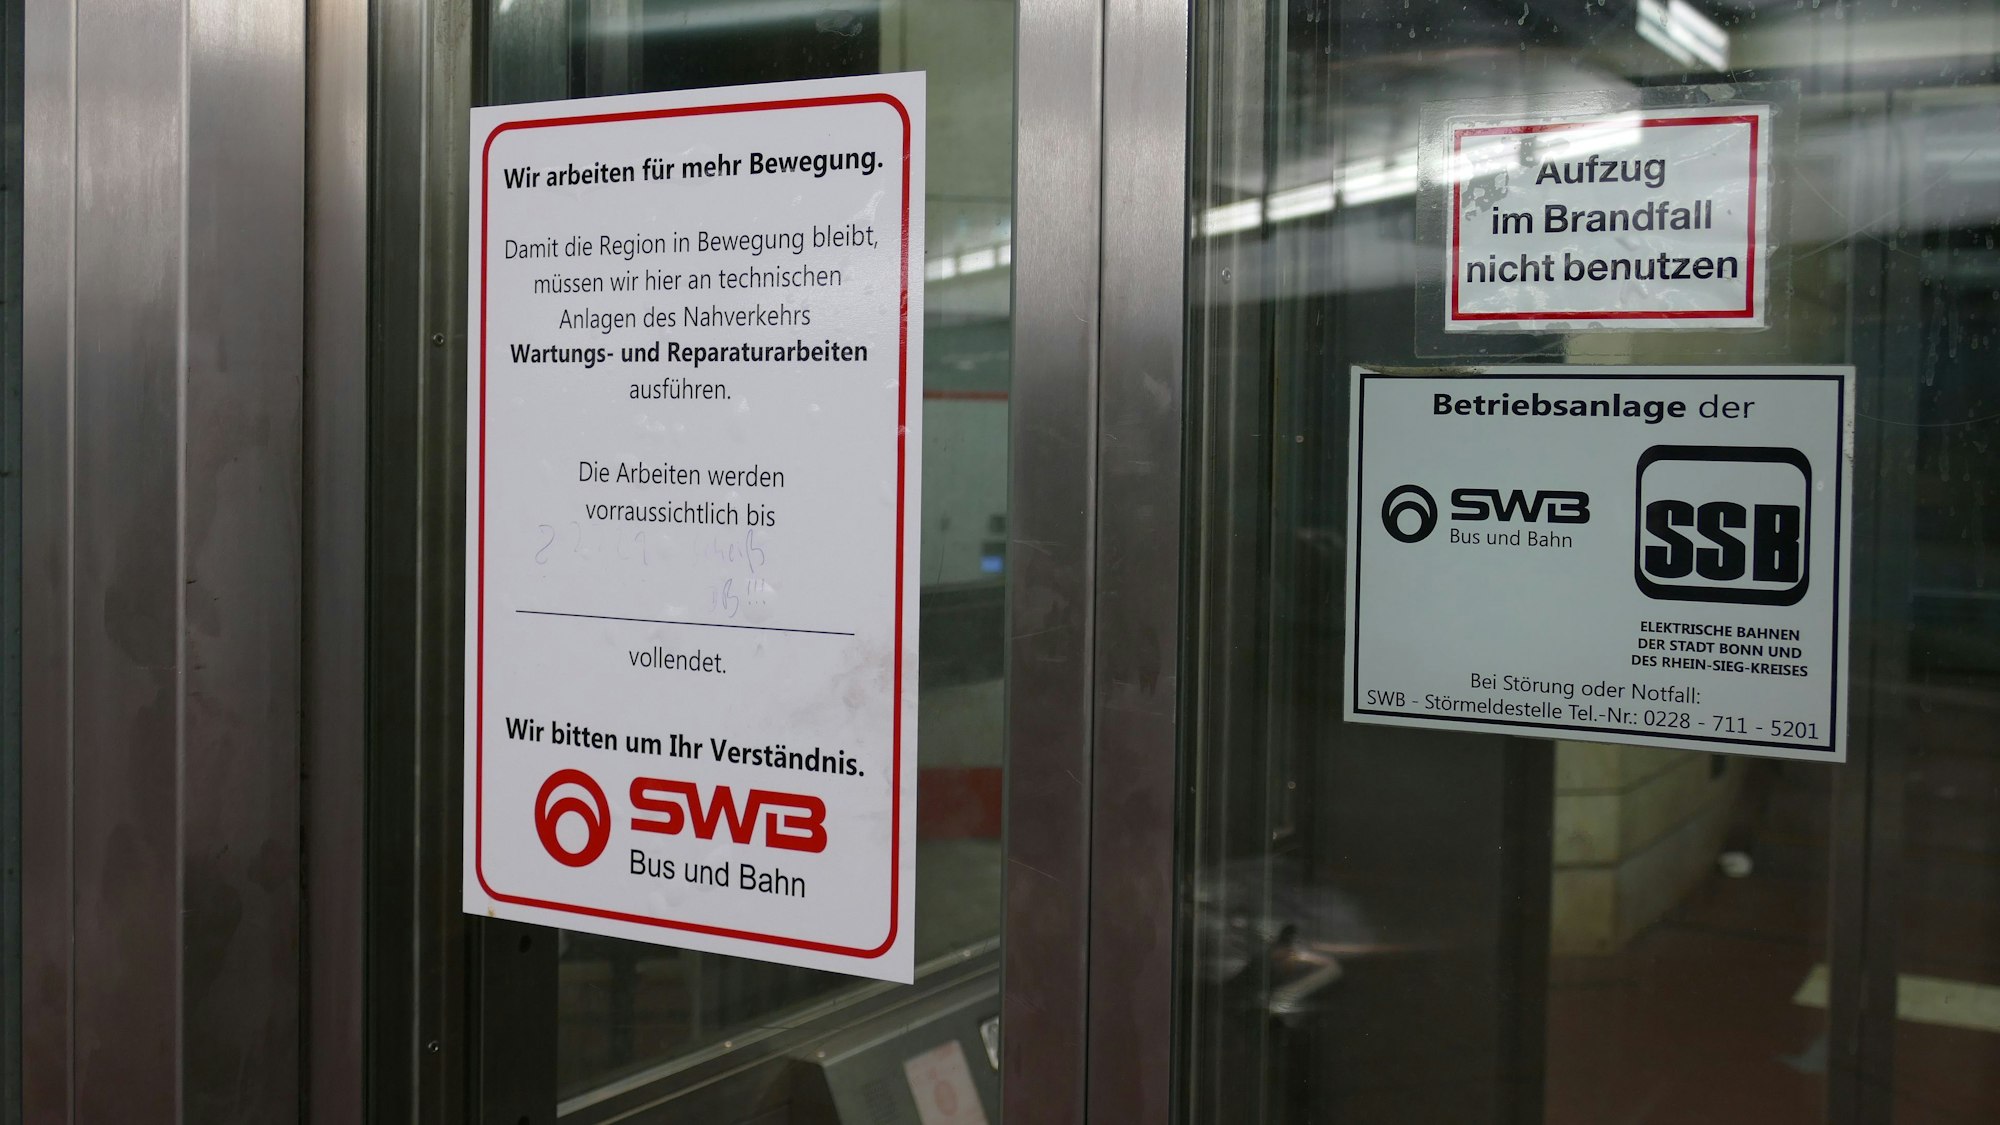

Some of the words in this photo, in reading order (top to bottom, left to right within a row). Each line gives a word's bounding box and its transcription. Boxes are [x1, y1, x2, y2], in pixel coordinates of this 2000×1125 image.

[504, 167, 540, 189] Wir
[547, 162, 634, 186] arbeiten
[642, 158, 674, 180] für
[683, 154, 741, 178] mehr
[750, 152, 882, 178] Bewegung.
[1536, 155, 1666, 188] Aufzug
[1493, 207, 1532, 234] im
[1545, 200, 1711, 233] Brandfall
[506, 240, 558, 259] Damit
[565, 236, 592, 256] die
[601, 236, 665, 260] Region
[672, 232, 690, 253] in
[699, 232, 803, 256] Bewegung
[813, 223, 879, 249] bleibt,
[534, 275, 603, 294] müssen
[610, 271, 639, 292] wir
[646, 270, 681, 290] hier
[689, 274, 710, 289] an
[719, 265, 841, 288] technischen
[1467, 254, 1554, 282] nicht
[1565, 253, 1737, 281] benutzen
[560, 308, 635, 334] Anlagen
[644, 307, 675, 327] des
[685, 304, 810, 326] Nahverkehrs
[511, 344, 613, 368] Wartungs-
[622, 341, 659, 362] und
[668, 340, 867, 368] Reparaturarbeiten
[630, 378, 730, 399] ausführen.
[1434, 393, 1686, 424] Betriebsanlage
[1699, 394, 1755, 418] der
[580, 461, 609, 482] Die
[617, 462, 699, 484] Arbeiten
[708, 465, 783, 487] werden
[586, 501, 737, 525] vorraussichtlich
[748, 504, 775, 526] bis
[1451, 488, 1590, 524] SWB
[1451, 528, 1480, 544] Bus
[1487, 530, 1520, 545] und
[1529, 531, 1571, 547] Bahn
[1645, 499, 1801, 583] SSB
[1639, 621, 1733, 638] ELEKTRISCHE
[1737, 627, 1799, 641] BAHNEN
[629, 646, 725, 673] vollendet.
[1639, 638, 1665, 650] DER
[1670, 640, 1715, 653] STADT
[1720, 643, 1763, 656] BONN
[1769, 646, 1801, 658] UND
[1632, 655, 1657, 666] DES
[1662, 655, 1808, 677] RHEIN-SIEG-KREISES
[1472, 673, 1495, 689] Bei
[1502, 675, 1575, 699] Störung
[1582, 681, 1625, 698] oder
[1632, 683, 1701, 705] Notfall:
[1367, 690, 1406, 708] SWB
[1424, 694, 1562, 720] Störmeldestelle
[1569, 704, 1638, 726] Tel.-Nr.:
[1644, 710, 1690, 729] 0228
[1713, 716, 1748, 734] 711
[1770, 720, 1819, 740] 5201
[506, 717, 544, 742] Wir
[552, 721, 617, 750] bitten
[627, 736, 661, 755] um
[670, 734, 702, 759] Ihr
[711, 738, 864, 776] Verständnis.
[630, 776, 828, 853] SWB
[631, 849, 675, 879] Bus
[685, 862, 728, 887] und
[740, 864, 805, 897] Bahn
